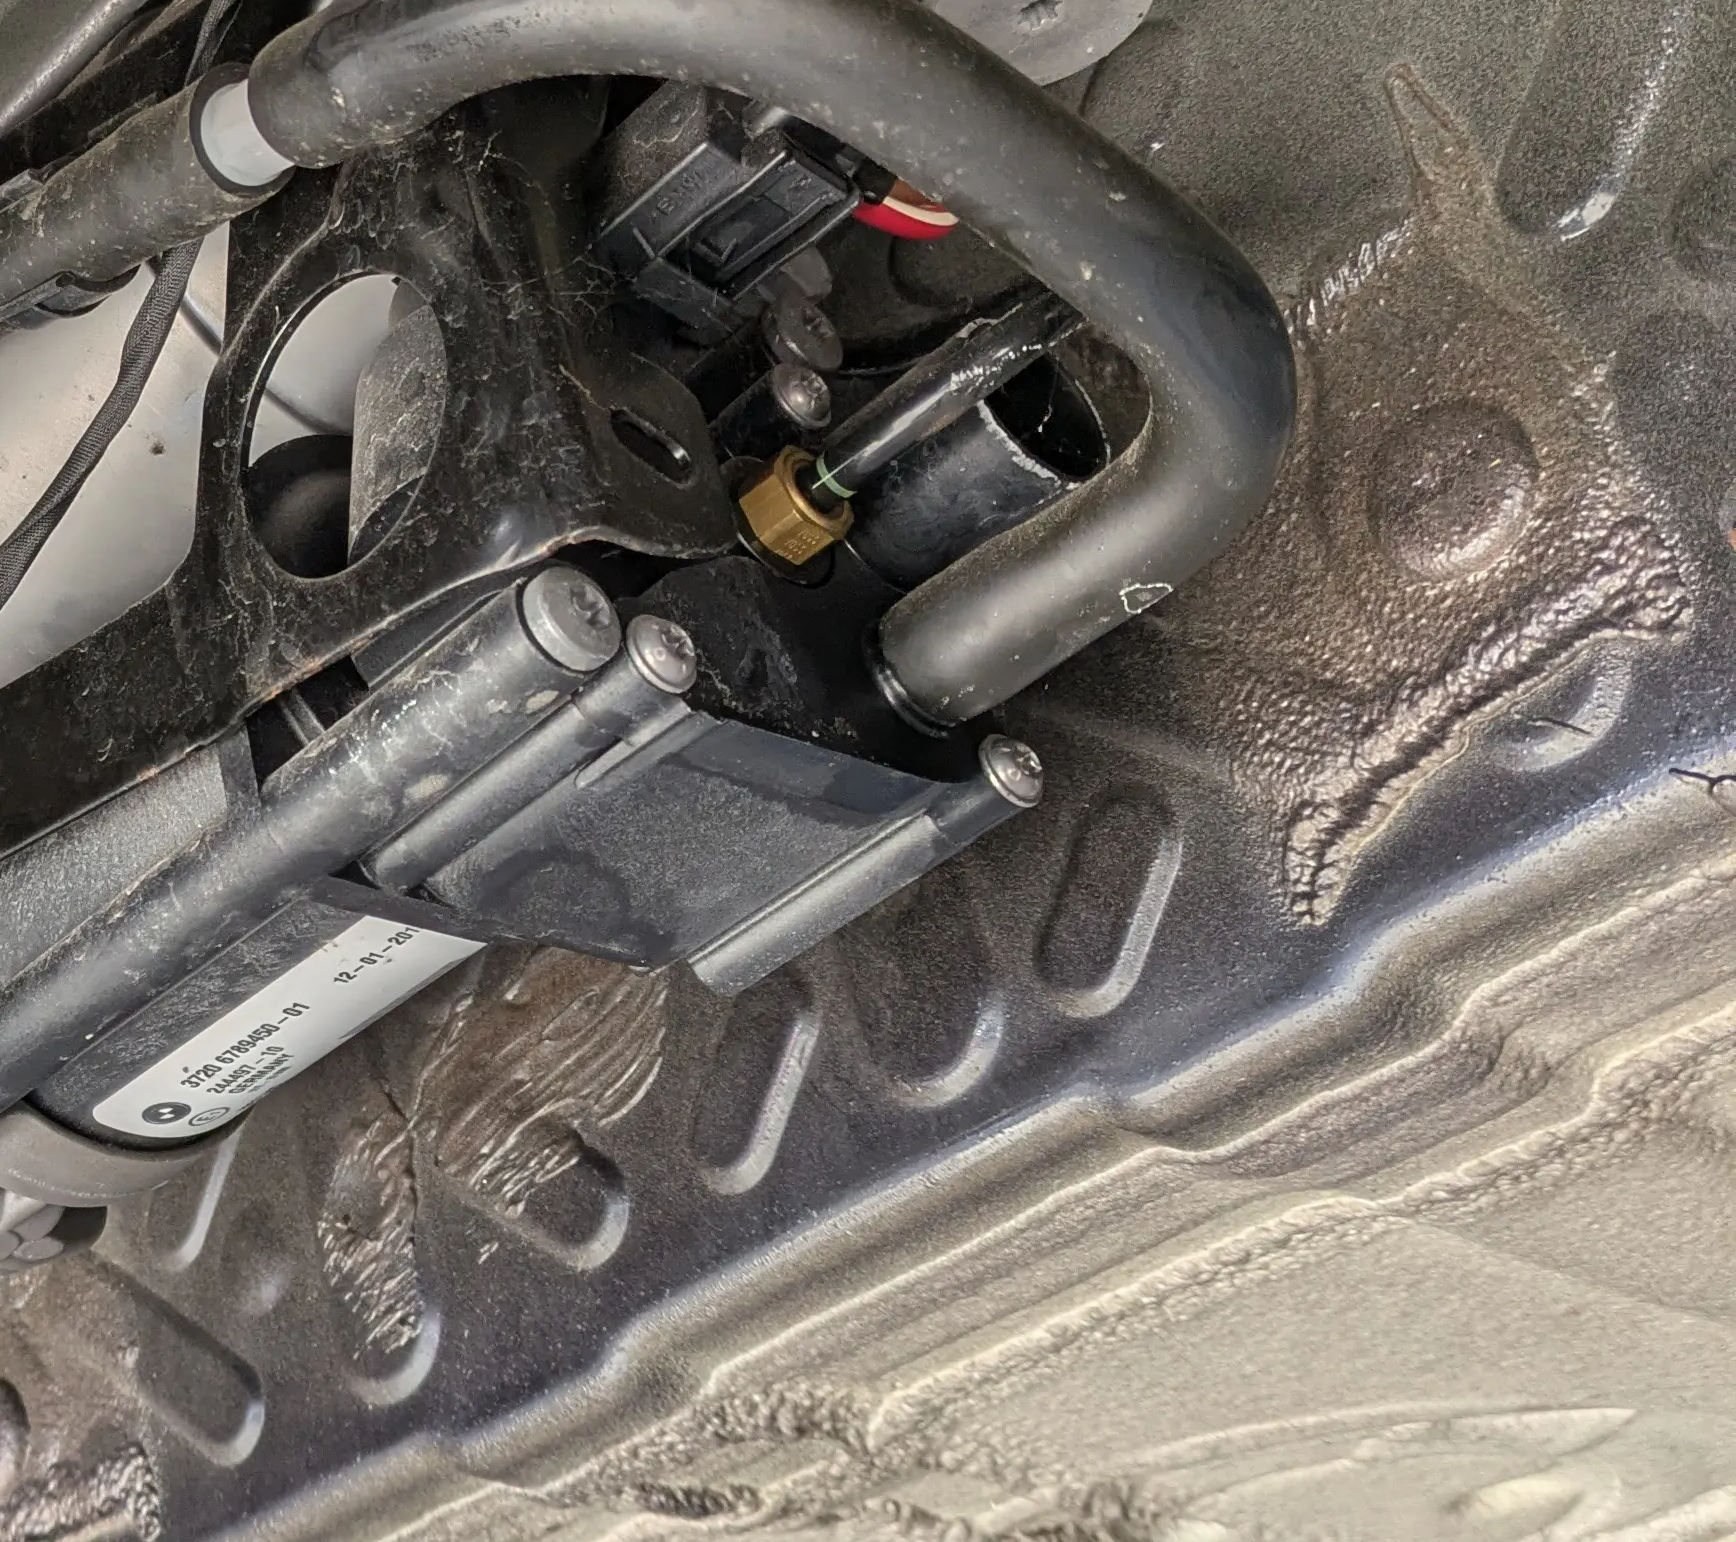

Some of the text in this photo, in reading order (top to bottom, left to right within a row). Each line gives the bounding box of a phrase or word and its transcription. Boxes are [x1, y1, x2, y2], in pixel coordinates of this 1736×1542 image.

[333, 925, 420, 985] 12-01-201
[180, 1063, 222, 1089] 3720
[214, 1002, 311, 1065] 6789450-01
[227, 1053, 295, 1095] GERMANY
